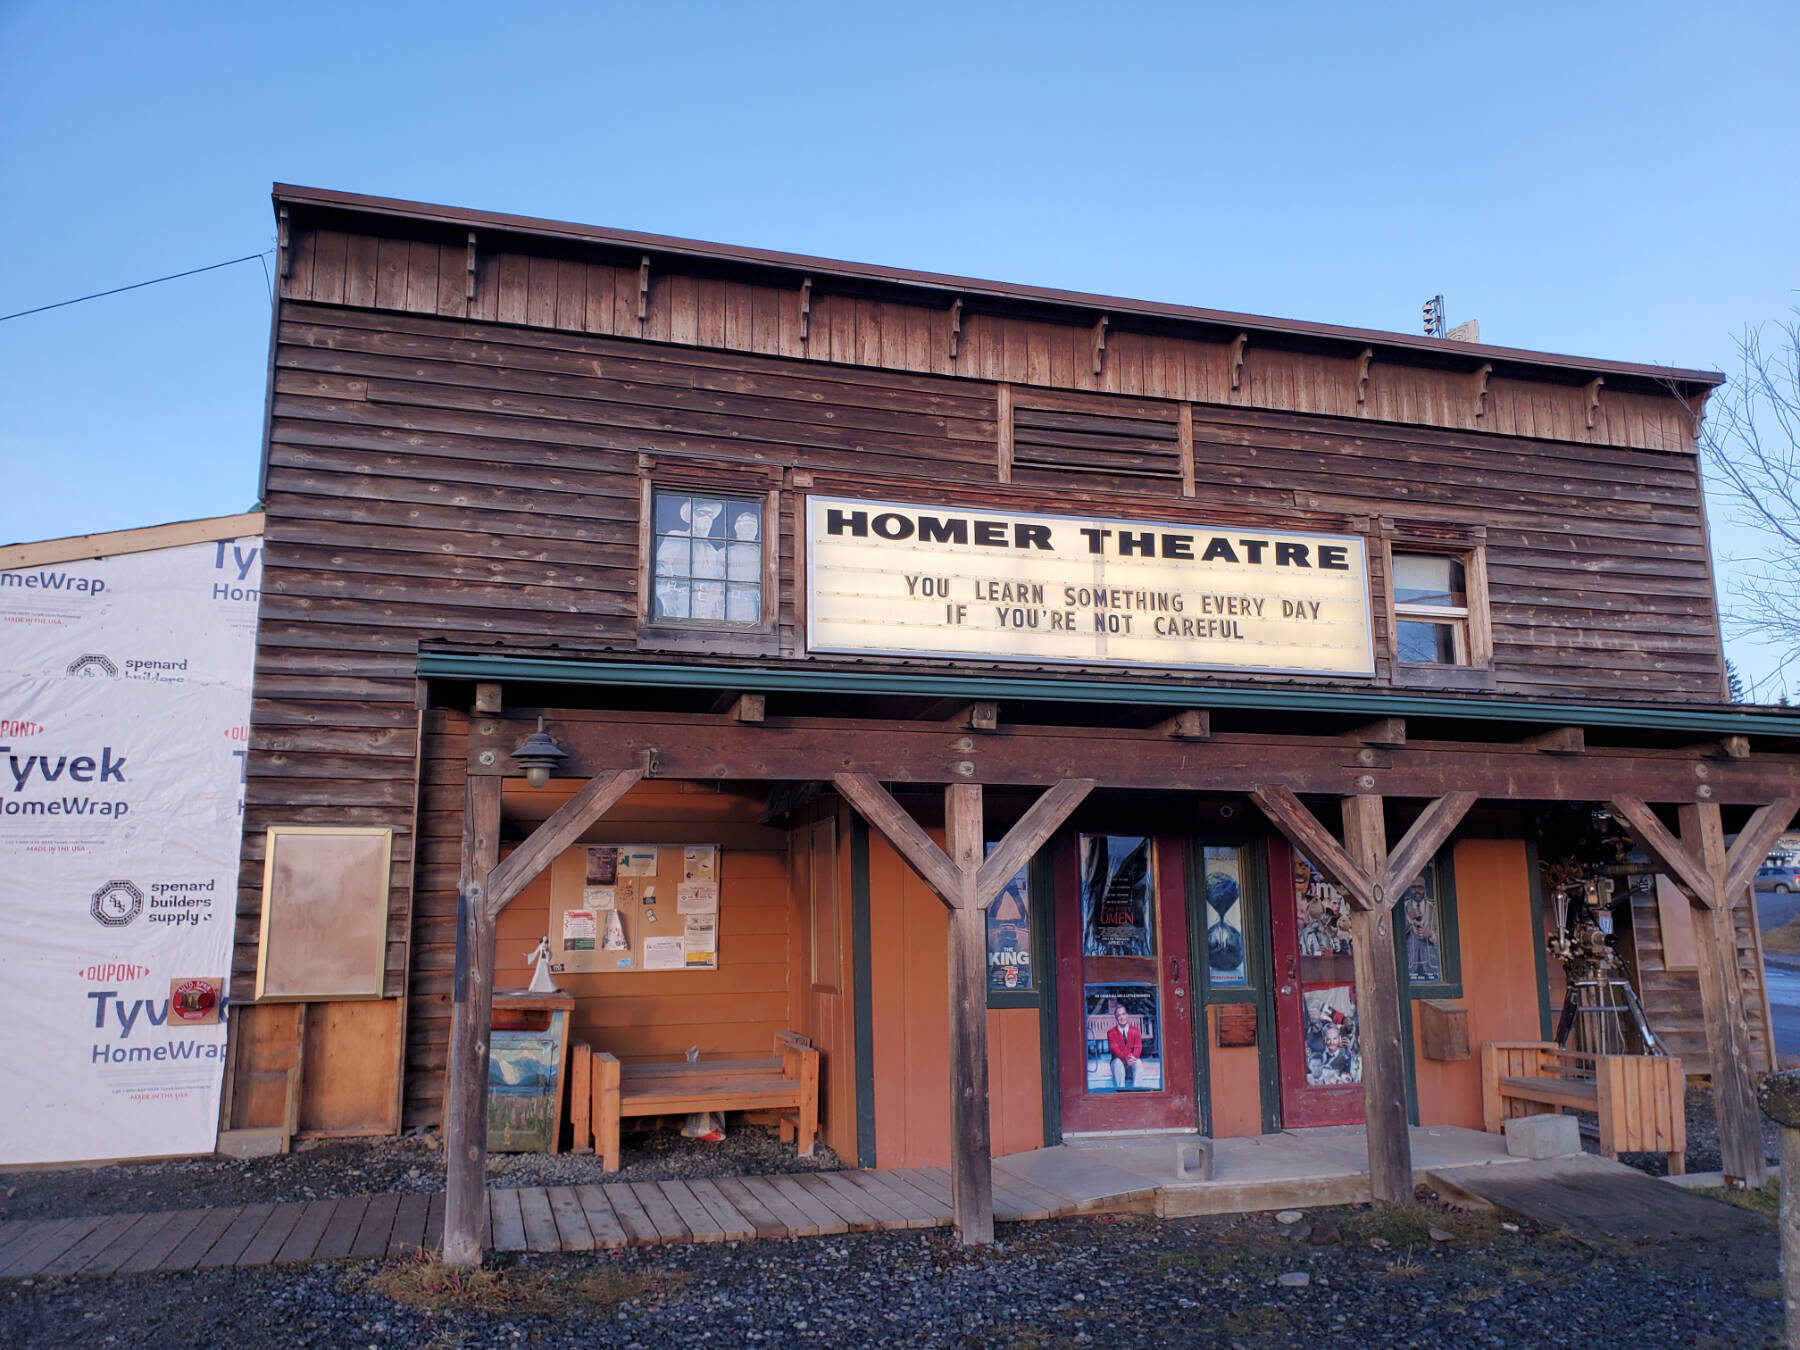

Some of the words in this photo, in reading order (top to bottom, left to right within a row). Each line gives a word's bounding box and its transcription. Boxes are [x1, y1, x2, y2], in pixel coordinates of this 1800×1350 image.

[826, 508, 1053, 552] HOMER
[1080, 527, 1350, 571] THEATRE
[905, 575, 951, 599] YOU
[975, 580, 1045, 606] LEARN
[1064, 586, 1184, 613] SOMETHING
[1201, 594, 1266, 618] EVERY
[1281, 598, 1322, 622] DAY
[945, 604, 969, 626] IF
[996, 607, 1077, 632] YOU'RE
[1094, 613, 1135, 634] NOT
[1153, 616, 1245, 640] CAREFUL
[125, 658, 188, 672] spenard
[151, 879, 215, 896] spenard
[150, 896, 212, 908] builders
[149, 909, 200, 926] supply
[1100, 911, 1135, 925] OMEN
[988, 951, 1030, 966] KING
[87, 963, 143, 983] DUPONT
